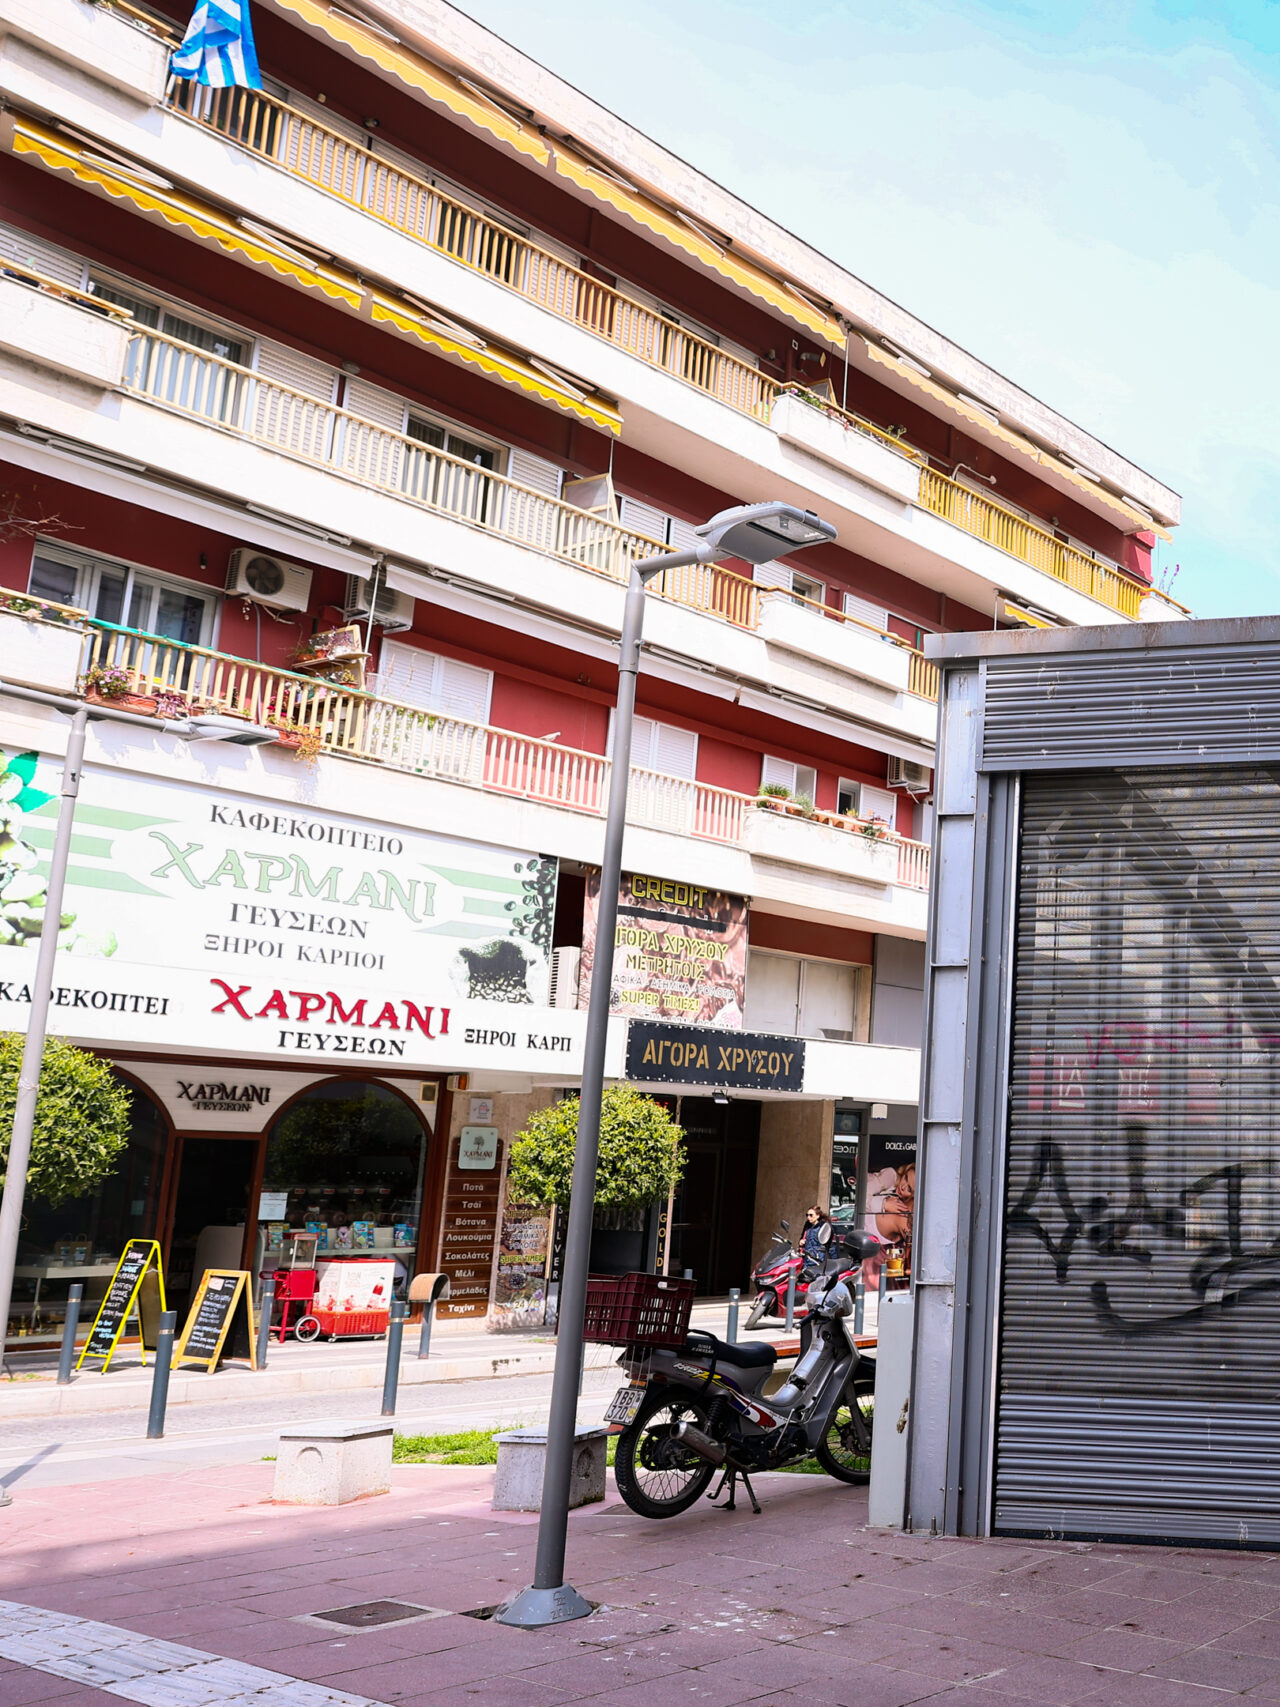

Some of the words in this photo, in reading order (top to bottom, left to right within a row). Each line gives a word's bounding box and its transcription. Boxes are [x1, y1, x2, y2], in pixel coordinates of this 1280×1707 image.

[209, 804, 403, 856] ΚΑΦΕΚΟΠΤΕΙΟ
[148, 831, 437, 922] ΧΑΡΜΑΝΙ
[632, 875, 707, 909] CREDIT
[230, 902, 369, 940] ΓΕΥΣΕΩΝ
[203, 933, 284, 961] ΞΗΡΟΙ
[296, 945, 386, 971] ΚΑΡΠΟΙ
[615, 927, 659, 951] ΓΟΡΑ
[663, 934, 728, 961] ΧΡΥΣΟΥ
[626, 954, 706, 979] ΜΕΤΡΗΤΟΙΣ
[613, 974, 642, 986] ΑΦΙΚΑ
[0, 981, 170, 1015] ΚΑΕΚΟΠΤΕΙ
[209, 978, 451, 1040] ΧΑΡΜΑΝΙ
[621, 991, 659, 1006] SUPER
[278, 1030, 406, 1057] ΓΕΥΣΕΩΝ
[464, 1028, 517, 1048] ΞΗΡΟΙ
[642, 1038, 709, 1070] ΑΓΟΡΑ
[717, 1046, 794, 1076] ΧΡΥΣΟΥ
[176, 1081, 271, 1105] ΧΑΡΜΑΝΙ
[462, 1183, 484, 1192] Ποτά
[455, 1217, 486, 1226] Βότανα
[446, 1232, 492, 1243] Λουκούμια
[552, 1205, 564, 1280] SILVER
[656, 1213, 667, 1267] GOLD
[445, 1251, 490, 1261] Σοκολάτες
[455, 1269, 475, 1278] Μέλι
[450, 1286, 488, 1296] ρμελάδες
[448, 1304, 475, 1314] Ταχίνι
[608, 1405, 628, 1420] 370
